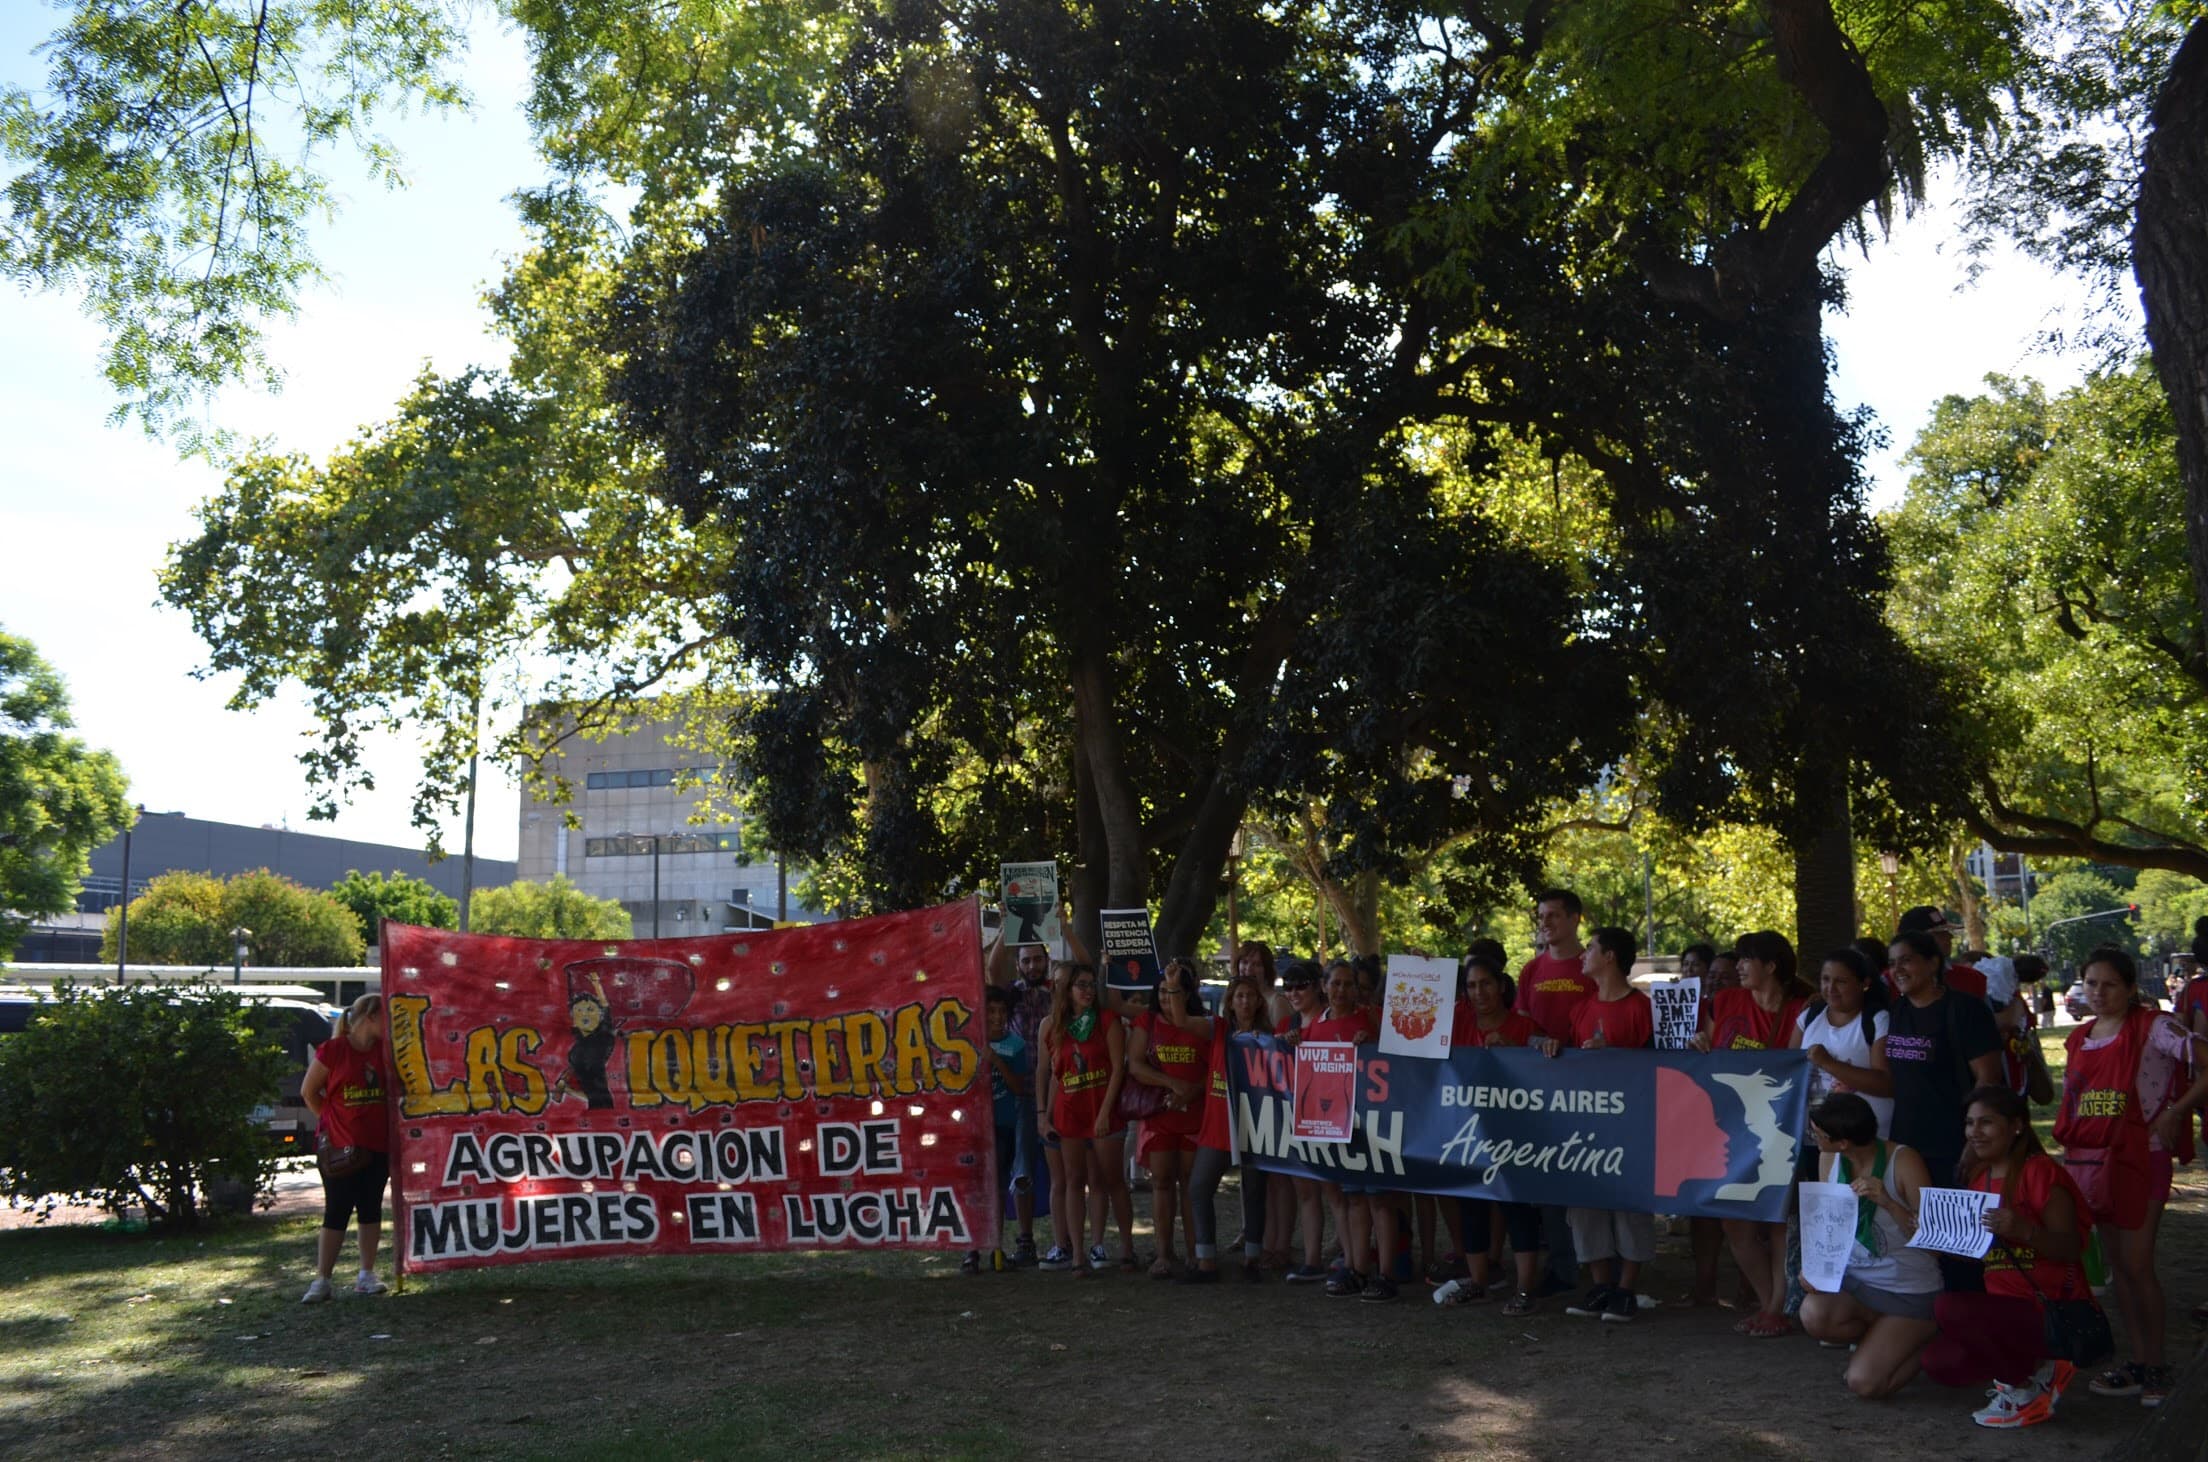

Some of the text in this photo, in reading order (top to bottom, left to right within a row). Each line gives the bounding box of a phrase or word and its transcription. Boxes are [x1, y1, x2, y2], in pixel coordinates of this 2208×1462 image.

[1103, 920, 1136, 929] RESPETA
[1106, 938, 1151, 948] O ESPERA
[1654, 988, 1697, 1004] GRAB
[388, 993, 548, 1118] LAS
[1300, 1048, 1346, 1062] VIVA LA
[1312, 1062, 1353, 1073] VAGINA
[1440, 1085, 1626, 1115] BUENOS AIRES
[2077, 1101, 2126, 1116] UJERES
[446, 1120, 899, 1184] AGRUPACION DE
[1439, 1112, 1625, 1185] Argentina
[411, 1189, 967, 1260] MUJERES EN LUCHA
